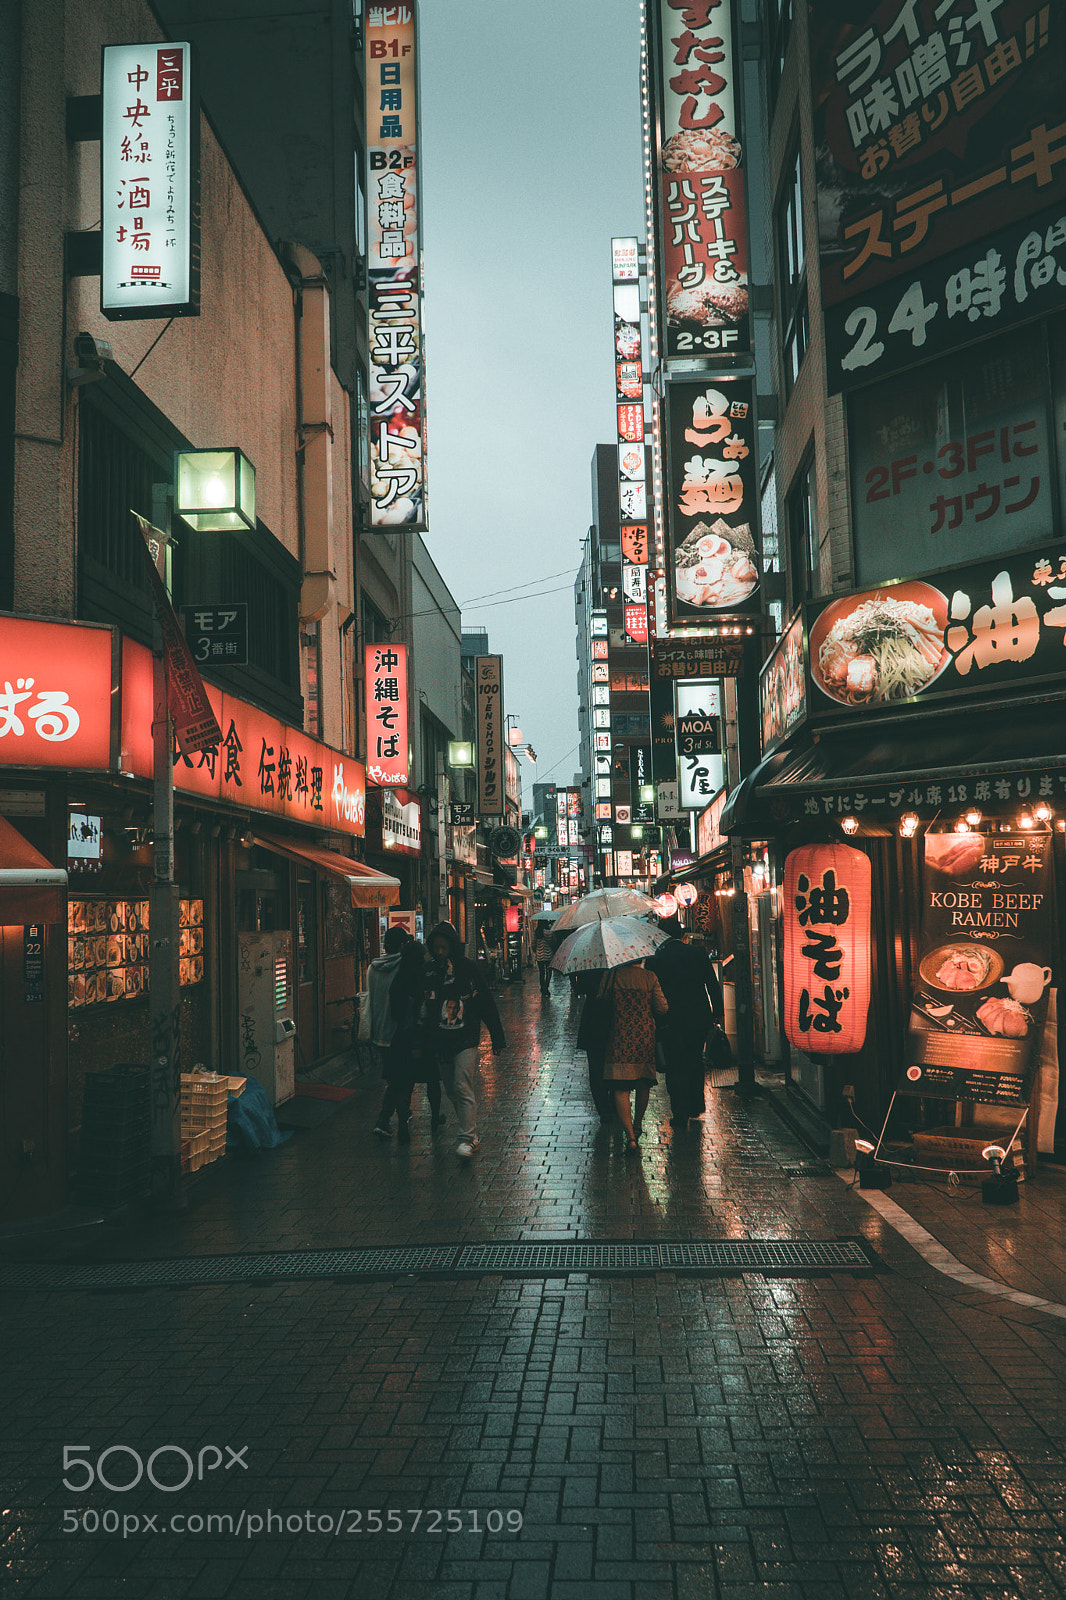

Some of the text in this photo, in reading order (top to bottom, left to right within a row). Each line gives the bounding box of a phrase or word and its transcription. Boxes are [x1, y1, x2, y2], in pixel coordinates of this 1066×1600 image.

[368, 5, 411, 27] 当ビル
[370, 39, 411, 58] B1F
[158, 54, 180, 97] 三平
[379, 62, 403, 139] 日用品
[116, 64, 152, 251] 中央線酒場
[370, 150, 413, 171] B2F
[378, 172, 406, 259] 食料品
[668, 178, 706, 290] ハンバーグ
[372, 280, 418, 509] 三平ストア
[194, 611, 237, 631] モア
[195, 637, 237, 661] 3番街
[479, 684, 499, 695] 100
[374, 648, 399, 758] 沖縄そば
[681, 720, 713, 733] MOA
[683, 737, 702, 754] 3rd
[258, 737, 323, 811] 伝統料理
[368, 765, 407, 783] やんばる
[453, 804, 471, 813] モア
[979, 854, 1043, 874] 神戸牛
[930, 891, 1044, 910] KOBE BEEF
[952, 911, 1019, 927] RAMEN
[27, 943, 41, 955] 22
[795, 869, 850, 1033] 油そば
